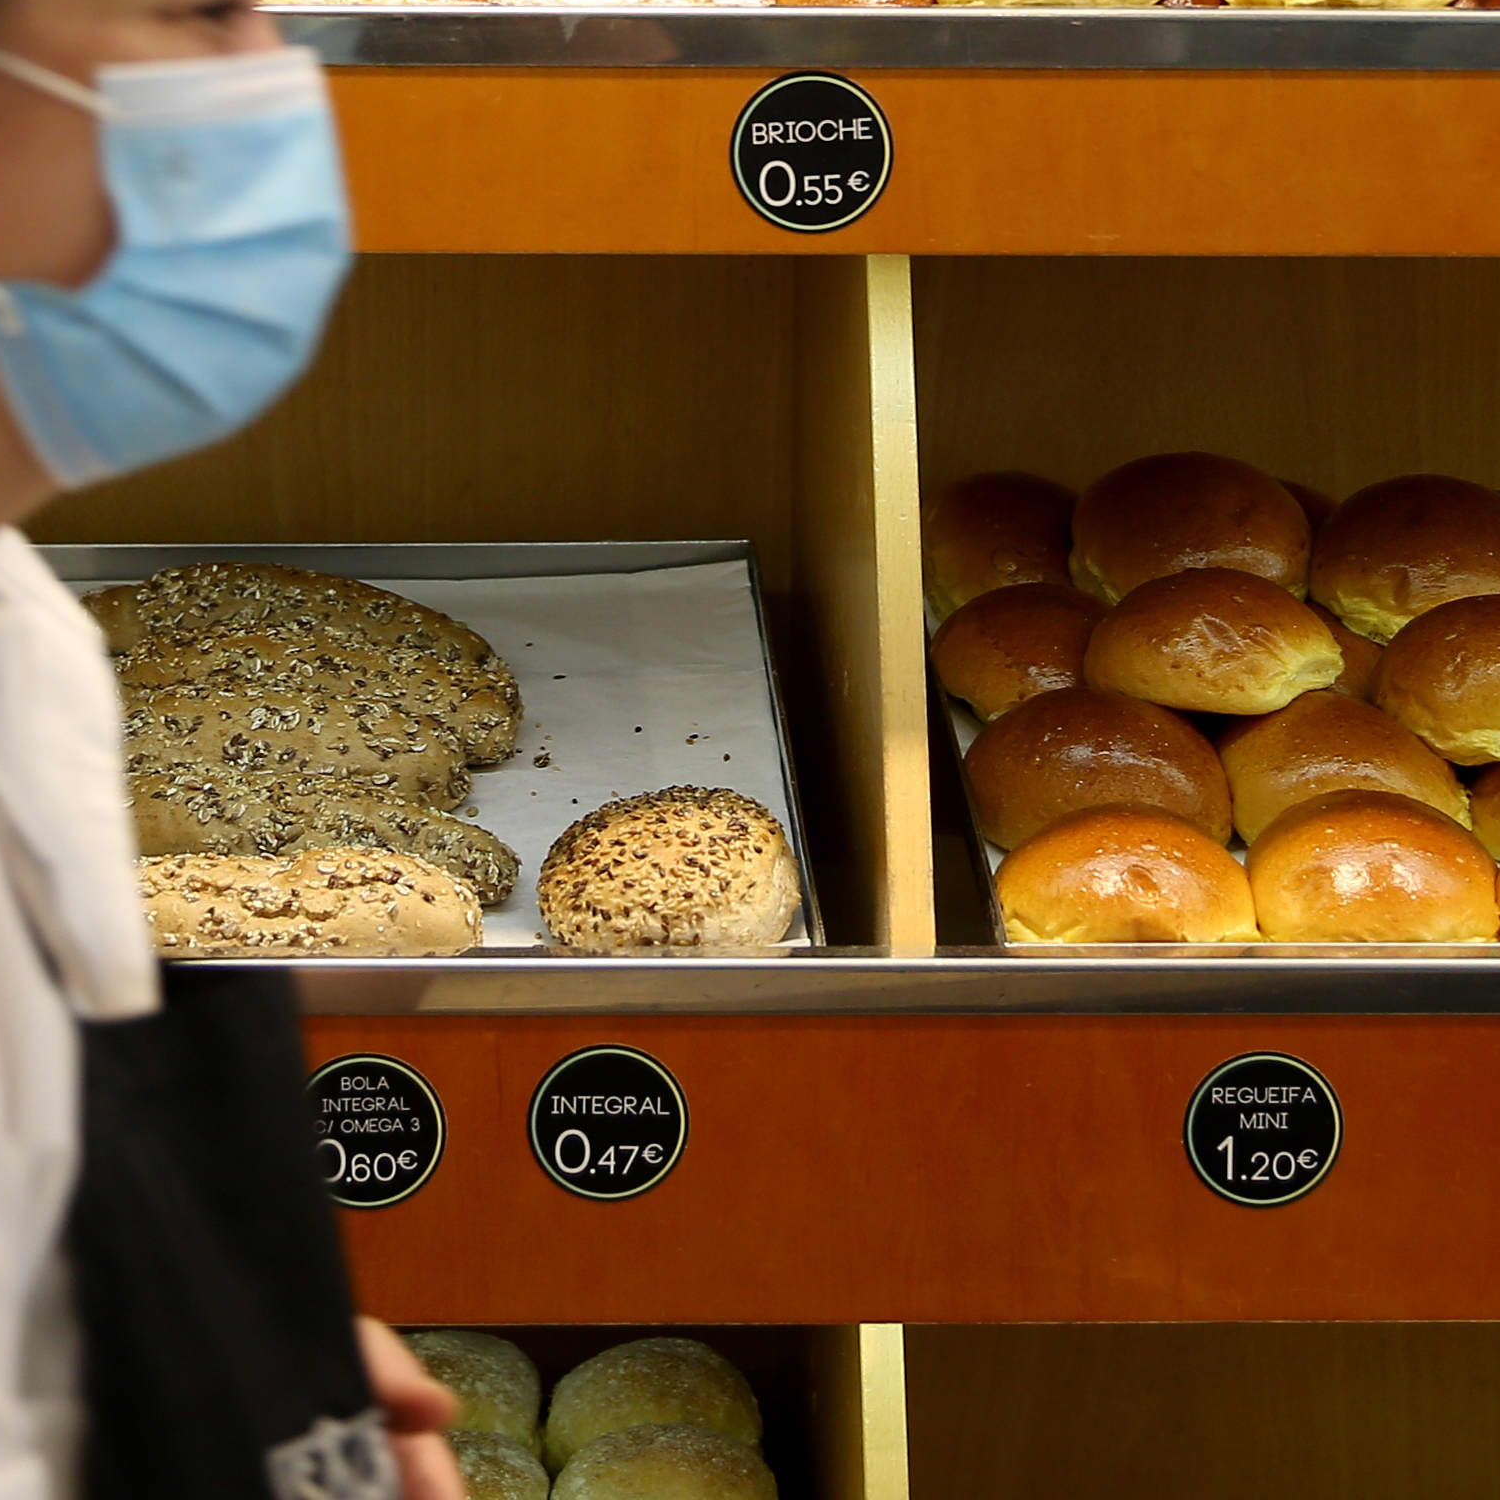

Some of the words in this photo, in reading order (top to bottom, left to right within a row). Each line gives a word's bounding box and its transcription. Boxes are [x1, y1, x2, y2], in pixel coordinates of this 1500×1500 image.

[751, 117, 873, 145] BRIOCHE
[340, 1075, 390, 1091] BOLA
[321, 1096, 411, 1113] INTEGRAL
[1211, 1086, 1317, 1105] REGUEIFA
[550, 1095, 670, 1116] INTEGRAL
[340, 1117, 404, 1134] OMEGA
[410, 1117, 421, 1132] 3
[1239, 1112, 1289, 1130] MINI
